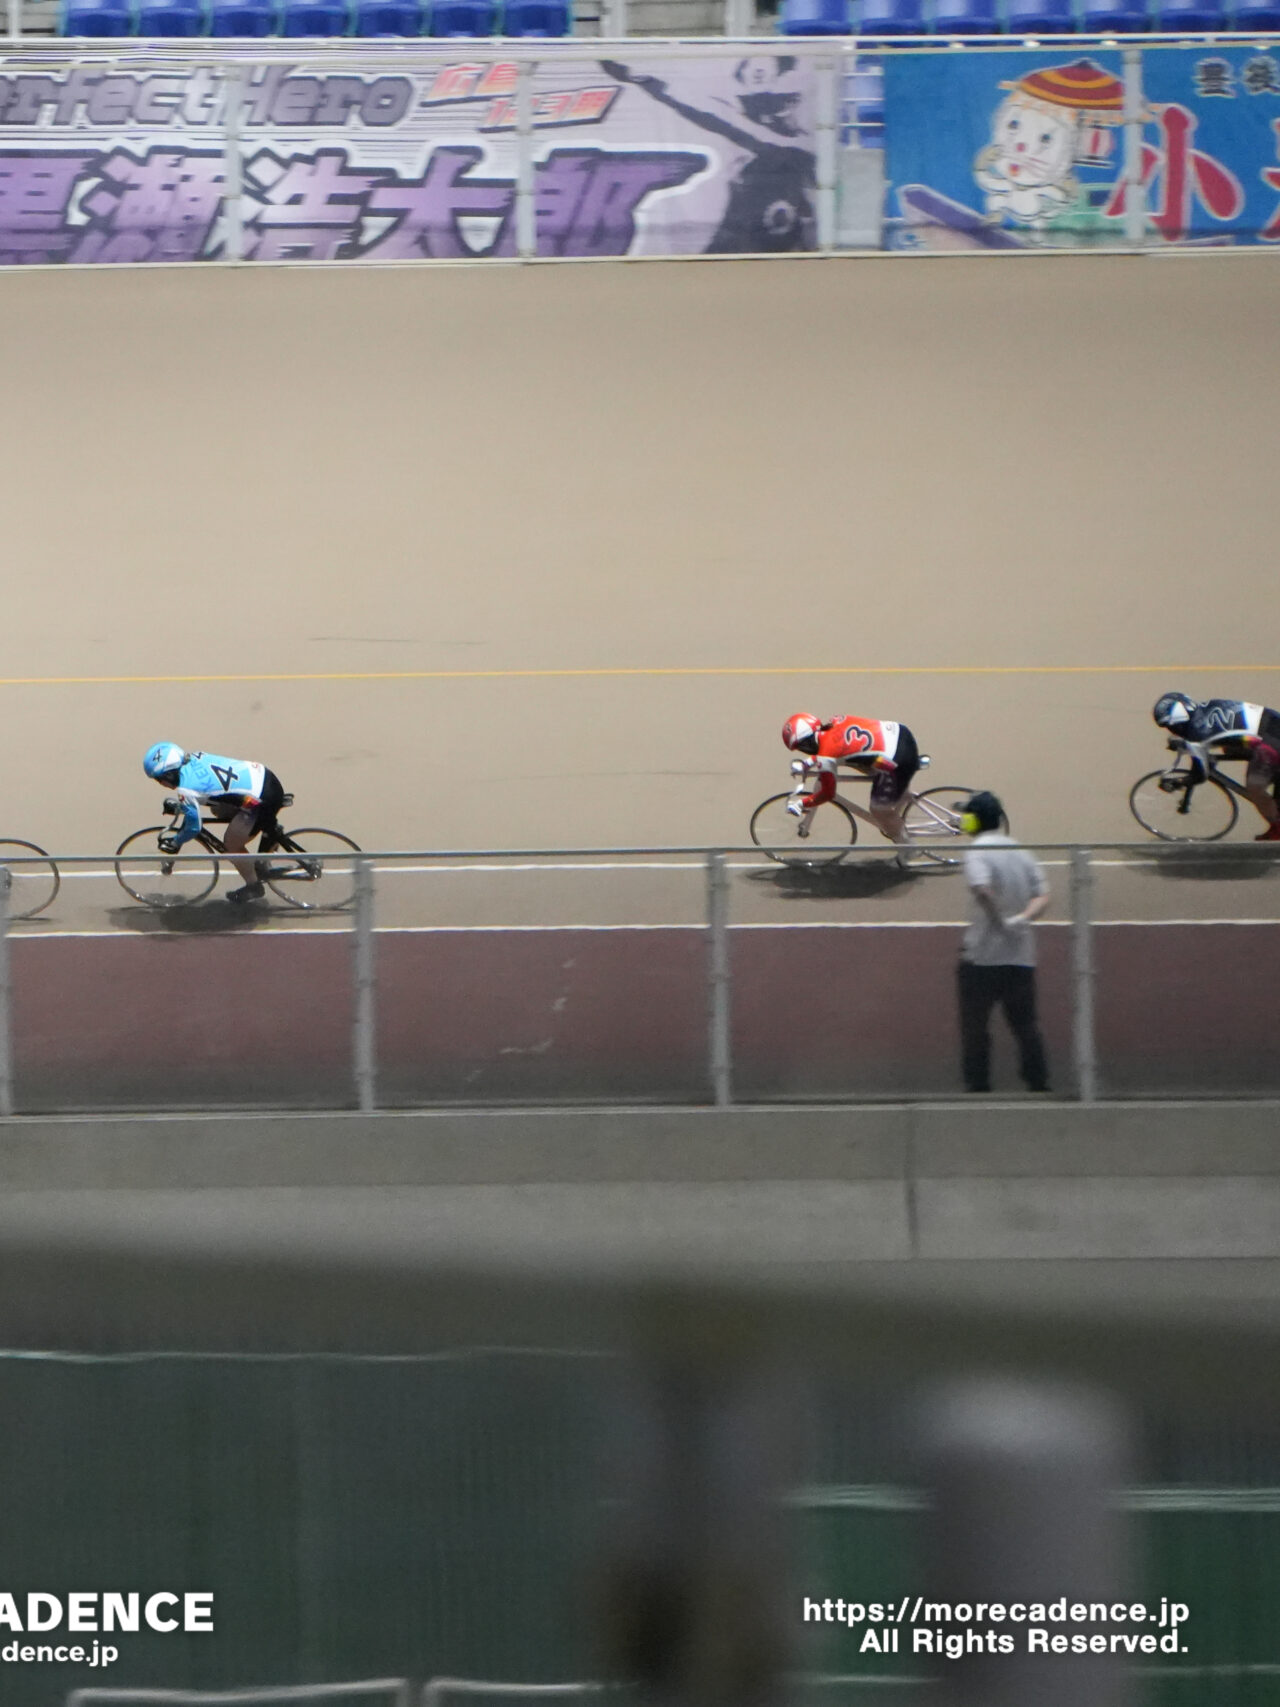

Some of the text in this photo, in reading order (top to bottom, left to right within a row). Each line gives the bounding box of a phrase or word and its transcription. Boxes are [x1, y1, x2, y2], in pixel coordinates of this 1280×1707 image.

[228, 64, 414, 126] Hero
[845, 725, 873, 751] 3
[152, 748, 164, 763] 4
[210, 764, 239, 792] 4
